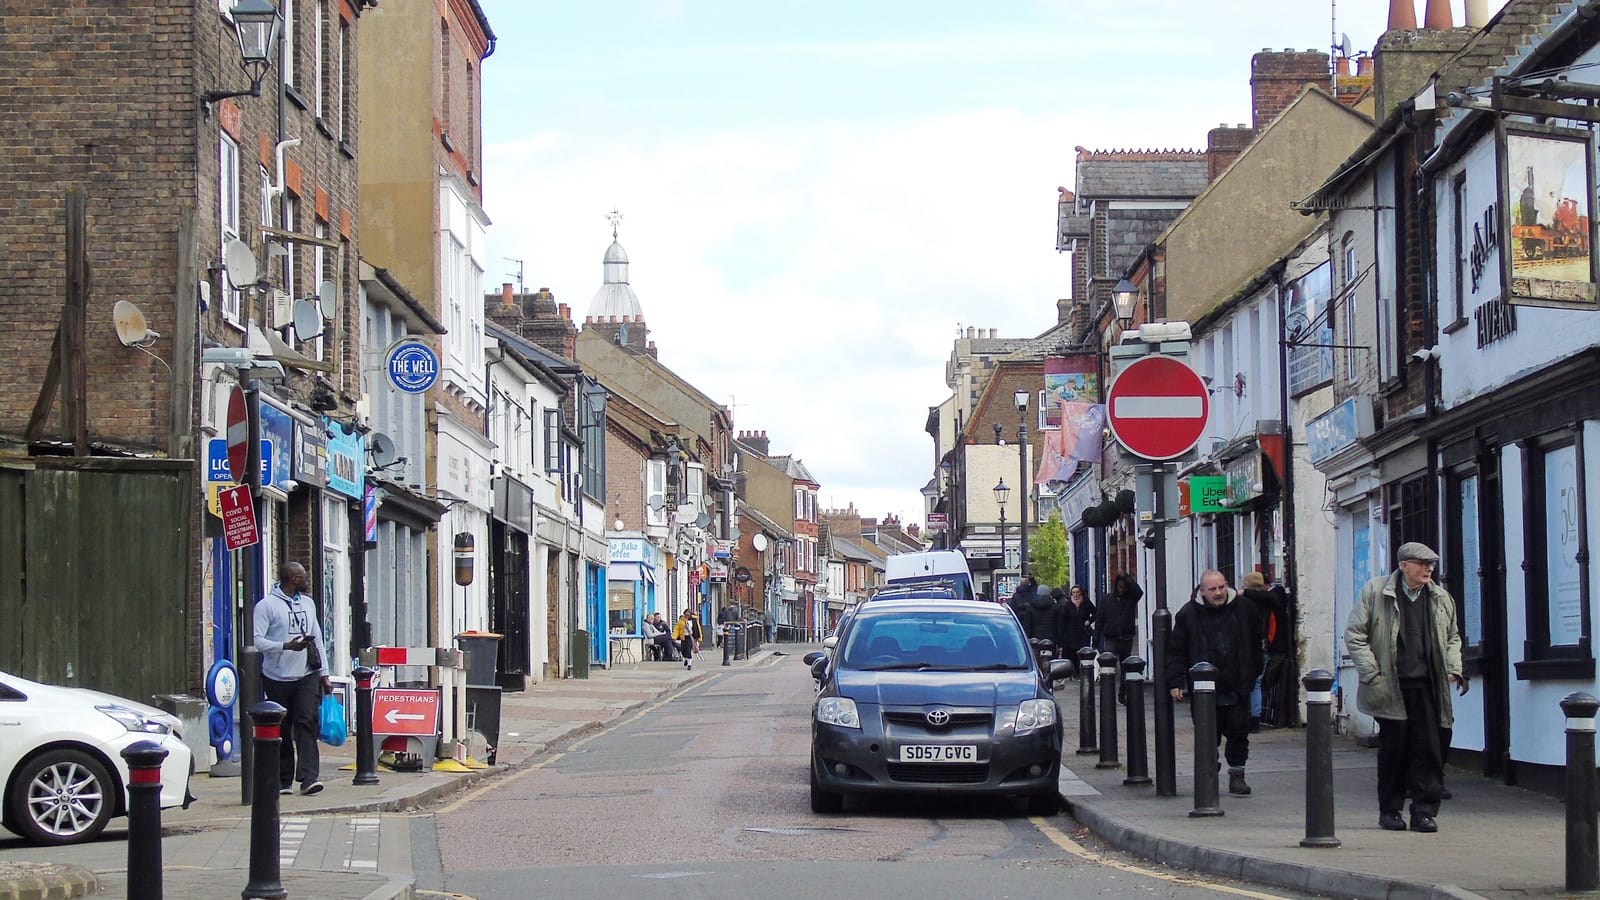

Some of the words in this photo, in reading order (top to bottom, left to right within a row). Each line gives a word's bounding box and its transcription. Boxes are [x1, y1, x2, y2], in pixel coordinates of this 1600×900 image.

[1474, 296, 1517, 349] TAVERN
[392, 360, 409, 373] THE
[412, 360, 435, 373] WELL
[212, 459, 267, 471] LICE
[1202, 487, 1227, 496] Uber
[226, 508, 242, 517] COVID
[231, 515, 248, 523] SOCIAL
[229, 520, 251, 530] DISTANCE
[609, 550, 630, 558] offee
[378, 695, 434, 703] PEDESTRIANS
[906, 746, 941, 759] SD57
[945, 746, 971, 759] GVG
